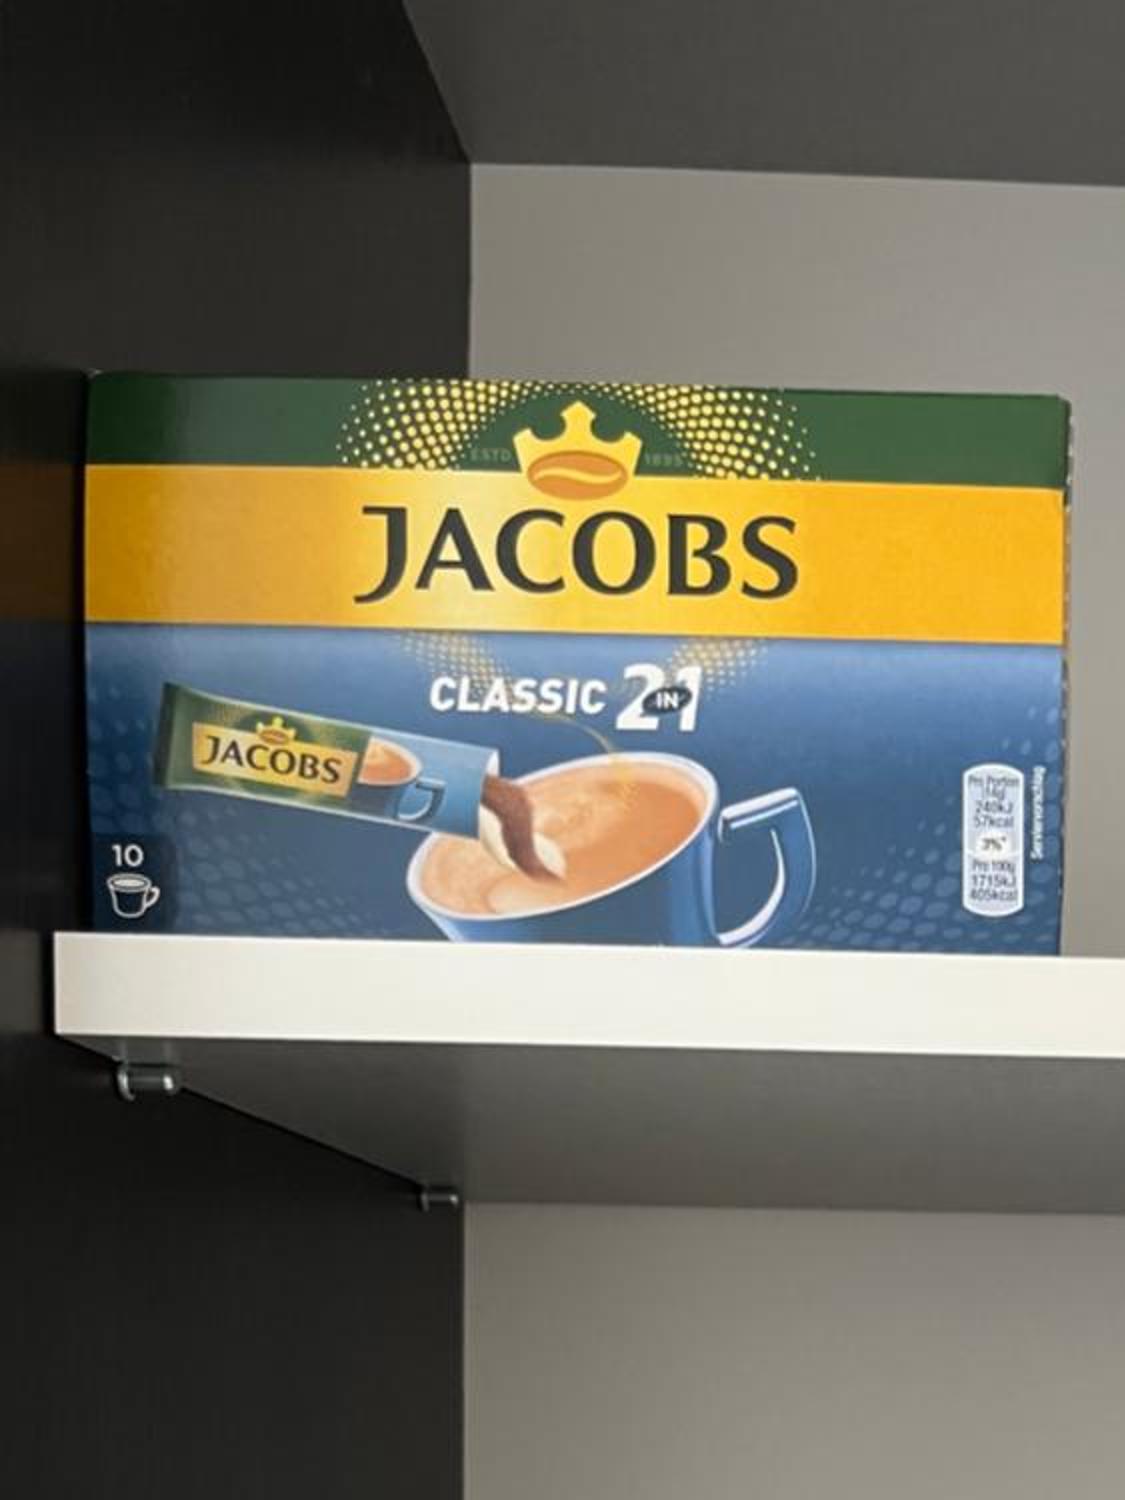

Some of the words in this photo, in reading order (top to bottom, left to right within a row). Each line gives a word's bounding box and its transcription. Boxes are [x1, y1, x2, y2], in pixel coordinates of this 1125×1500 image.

[353, 504, 800, 605] JACOBS
[429, 675, 609, 717] CLASSIC
[199, 734, 344, 785] JACOBS
[111, 844, 144, 868] 10
